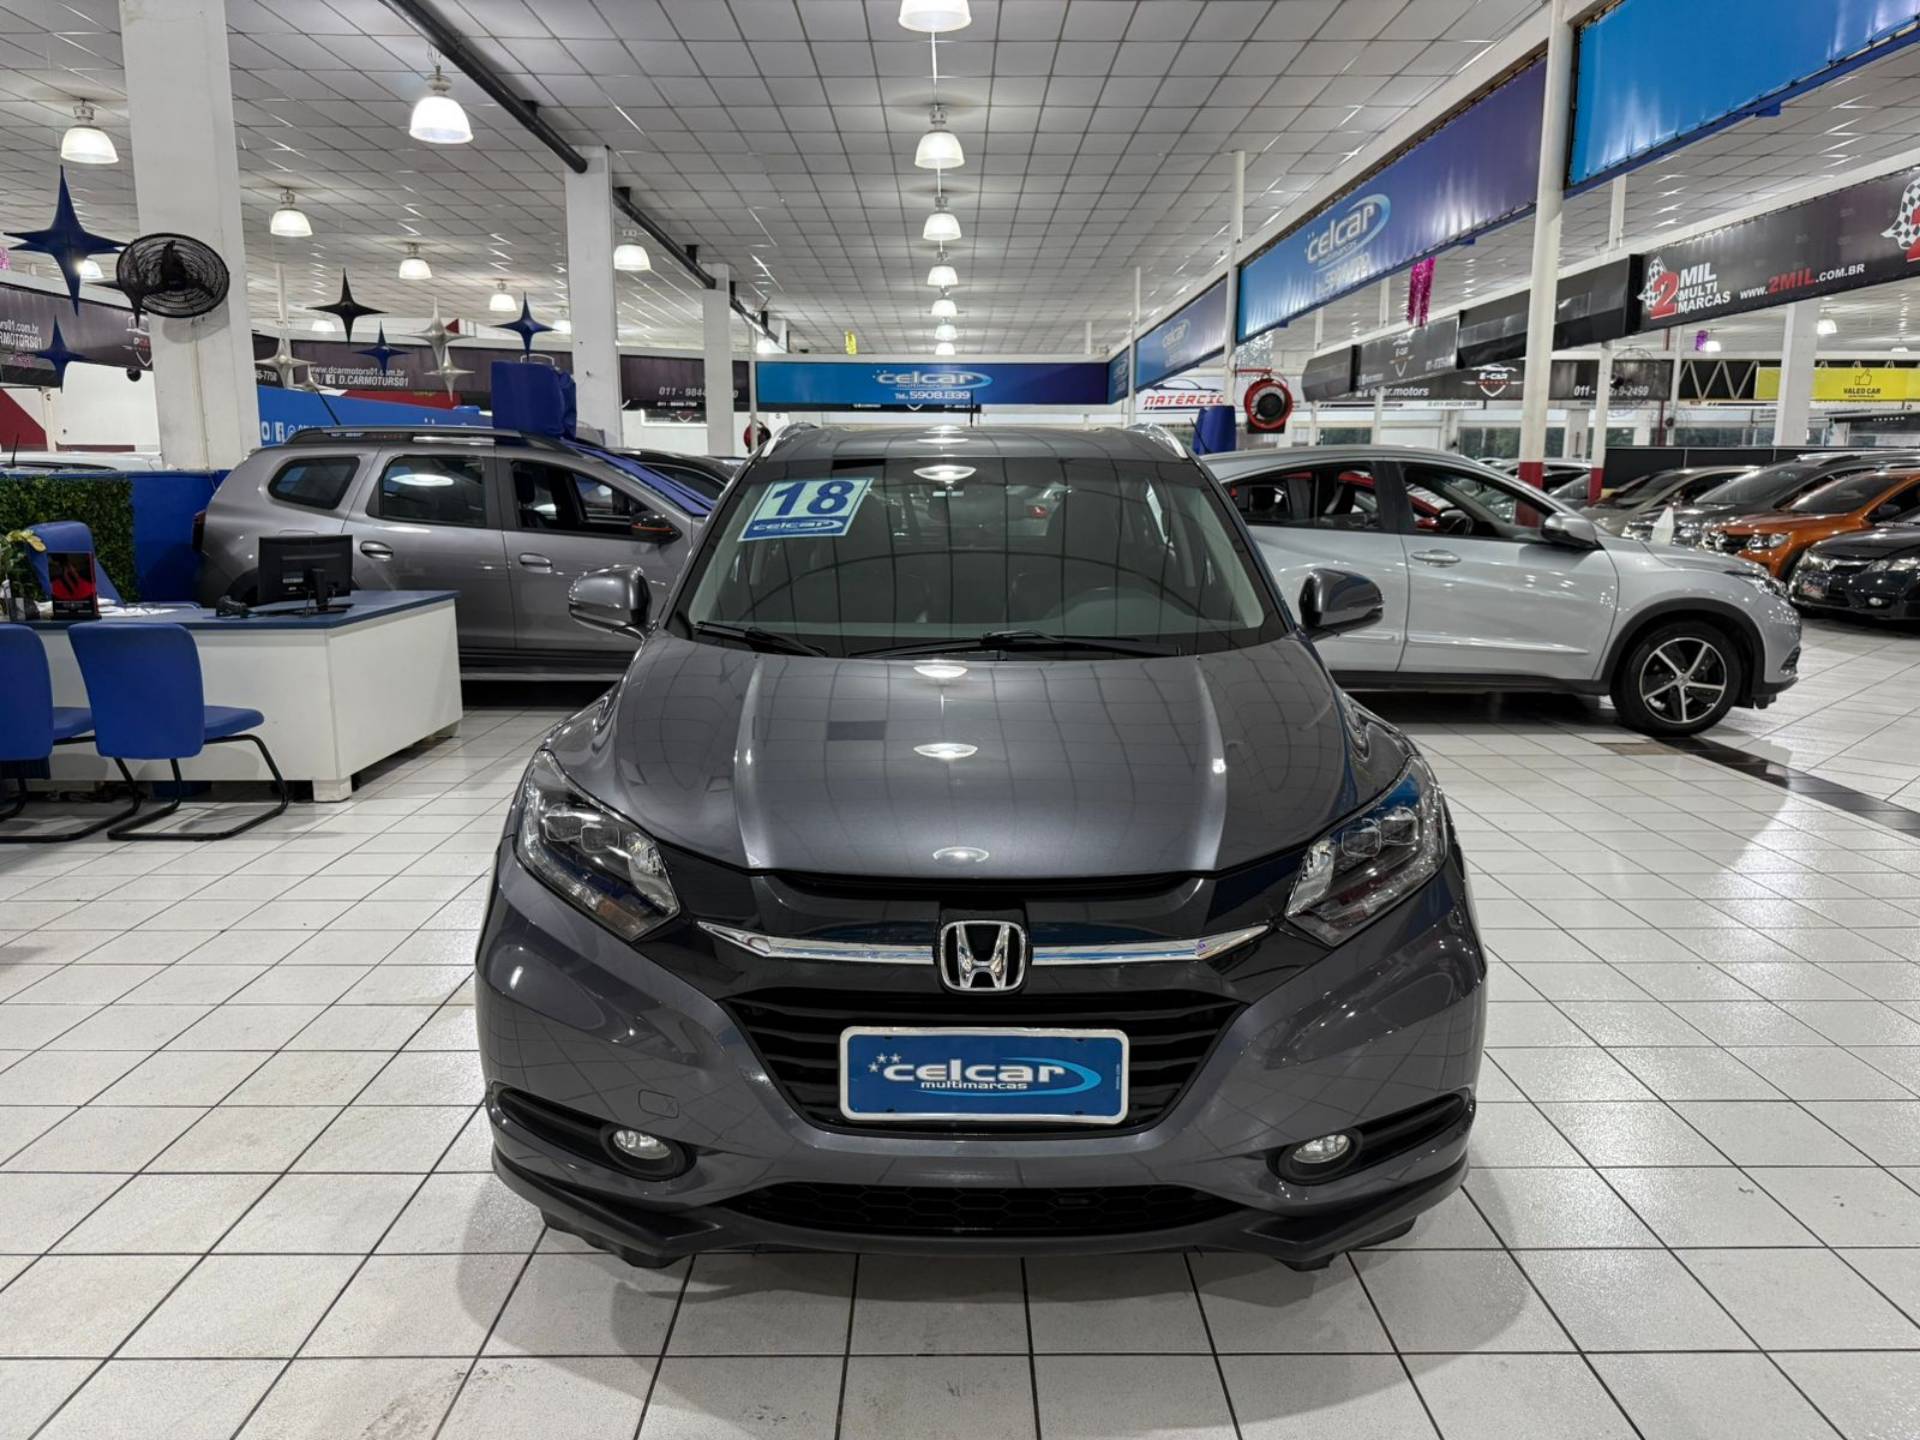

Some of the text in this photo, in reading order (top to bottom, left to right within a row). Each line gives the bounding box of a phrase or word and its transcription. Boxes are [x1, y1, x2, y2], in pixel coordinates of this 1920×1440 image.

[1307, 203, 1375, 263] celcar
[1680, 262, 1717, 288] MIL
[1678, 281, 1718, 302] MULTI
[1678, 291, 1731, 314] MARCAS
[878, 371, 974, 384] celcar
[773, 481, 854, 516] 18
[883, 1059, 1065, 1083] celcar
[920, 1080, 1028, 1090] multimarcas
